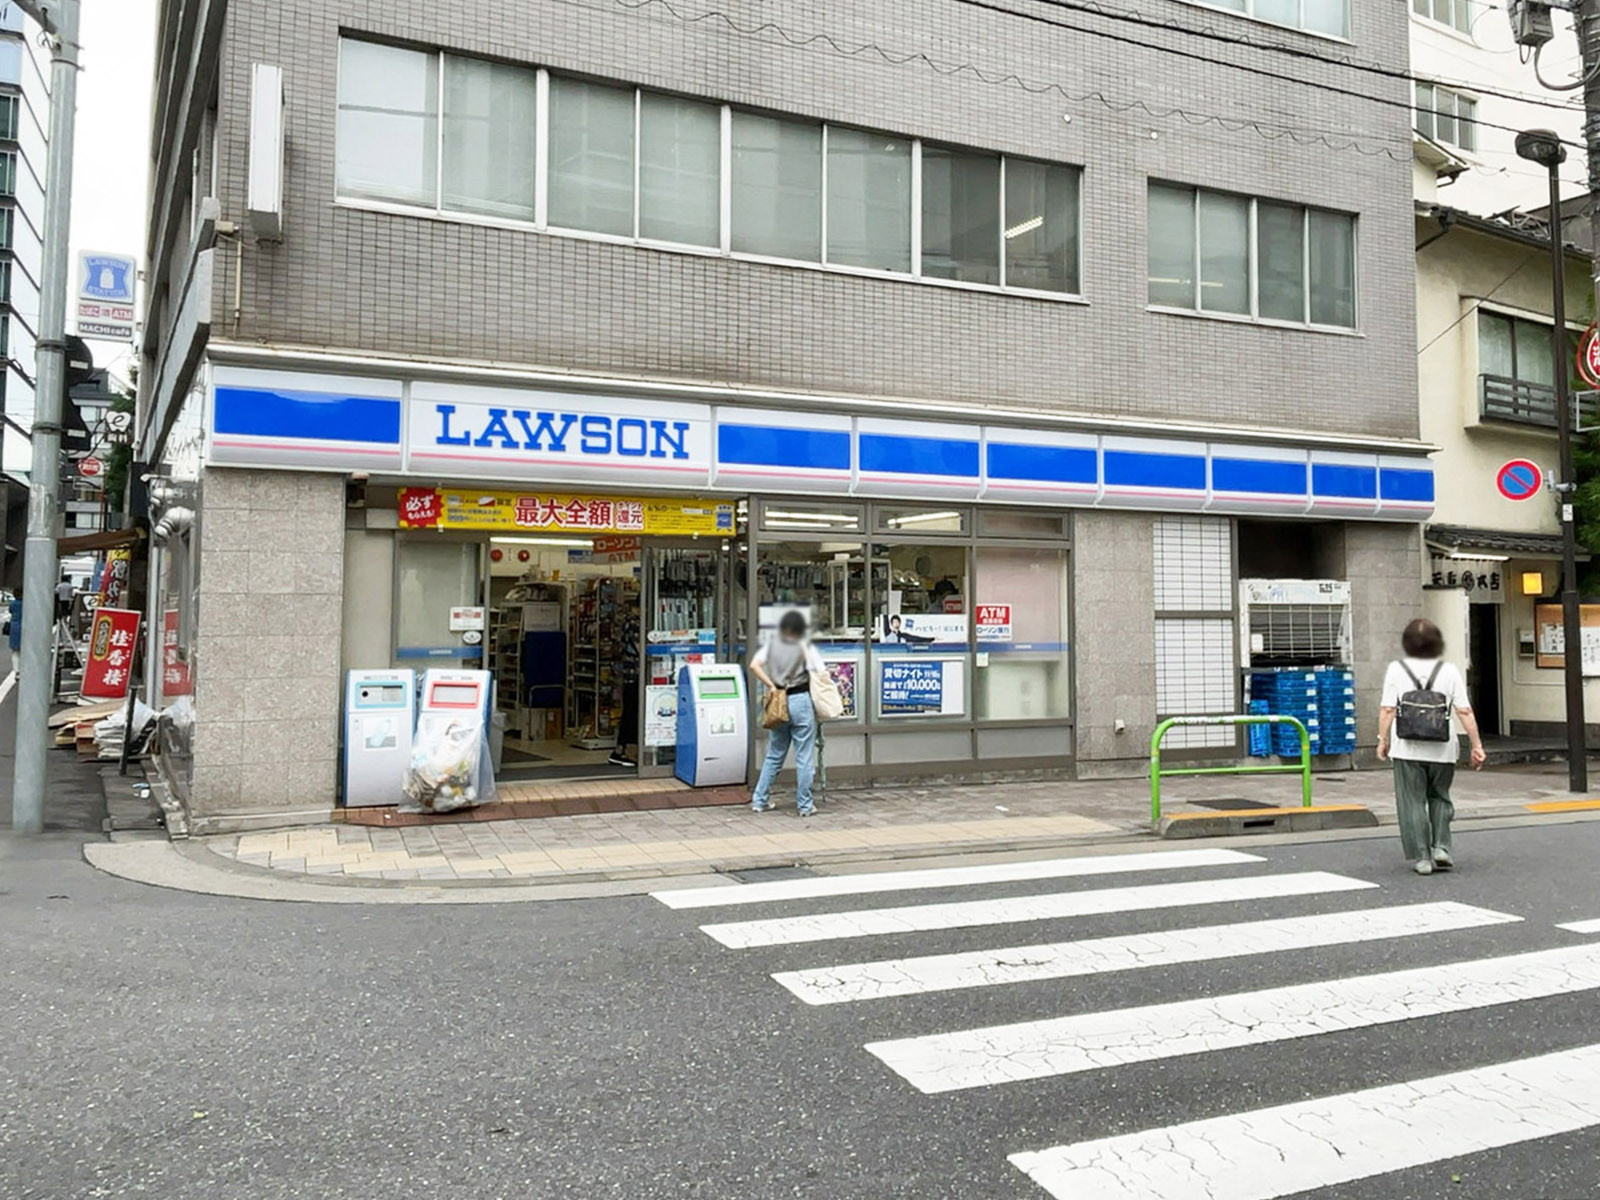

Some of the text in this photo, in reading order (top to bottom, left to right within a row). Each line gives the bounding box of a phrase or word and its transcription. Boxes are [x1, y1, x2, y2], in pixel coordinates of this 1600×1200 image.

[88, 257, 127, 270] LAWSON
[113, 309, 132, 319] ATM
[435, 404, 690, 460] LAWSON
[405, 494, 434, 512] 必ず
[616, 501, 643, 510] ポイント
[515, 497, 612, 527] 最大全額
[617, 510, 643, 524] 還元
[608, 551, 635, 563] ATM
[979, 607, 1006, 618] ATM
[884, 668, 923, 679] 貸切ナイト
